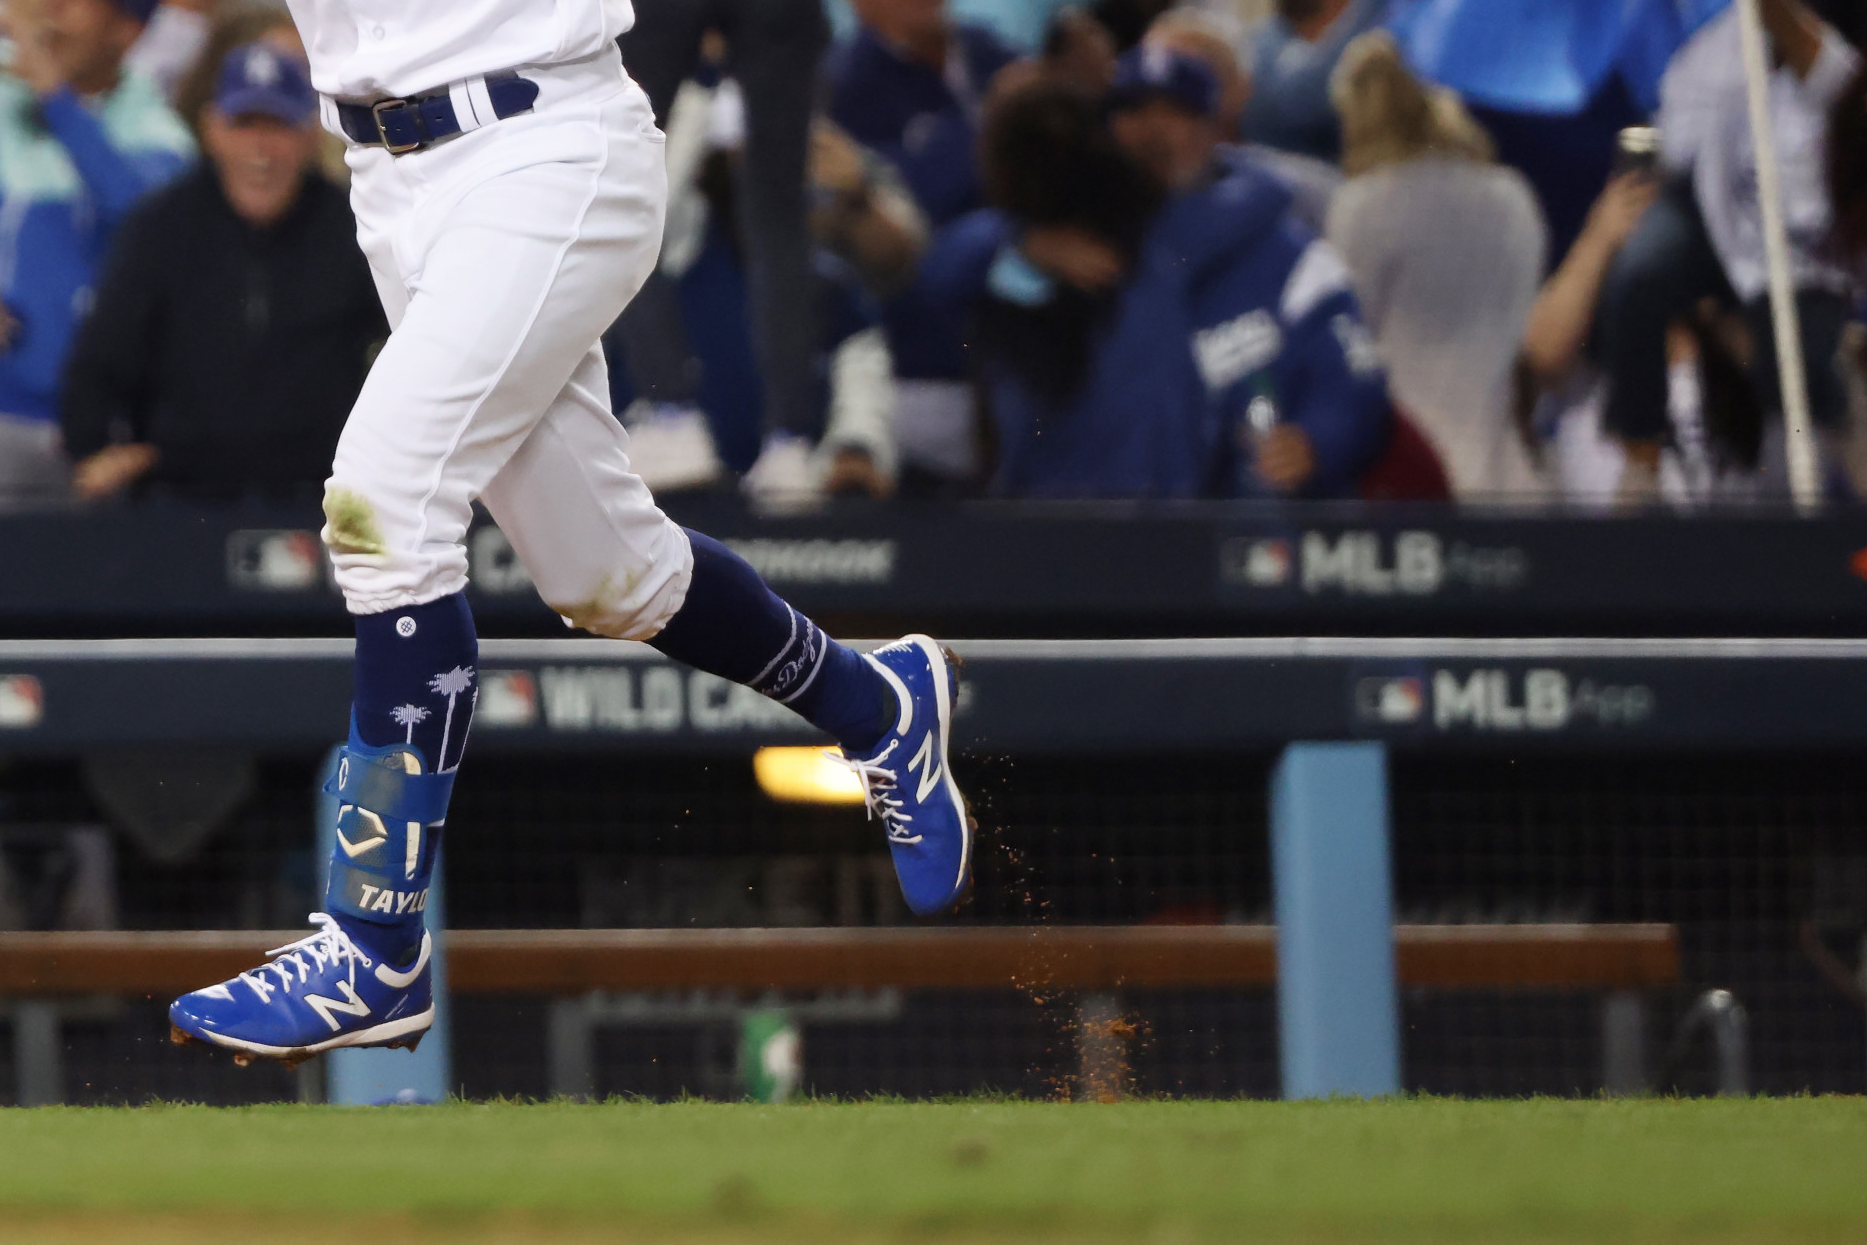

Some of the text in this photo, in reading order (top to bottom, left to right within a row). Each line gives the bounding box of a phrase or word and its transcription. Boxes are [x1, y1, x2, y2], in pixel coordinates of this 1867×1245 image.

[1299, 530, 1443, 594] MLB
[537, 665, 682, 730] WILD
[1433, 668, 1570, 730] MLB
